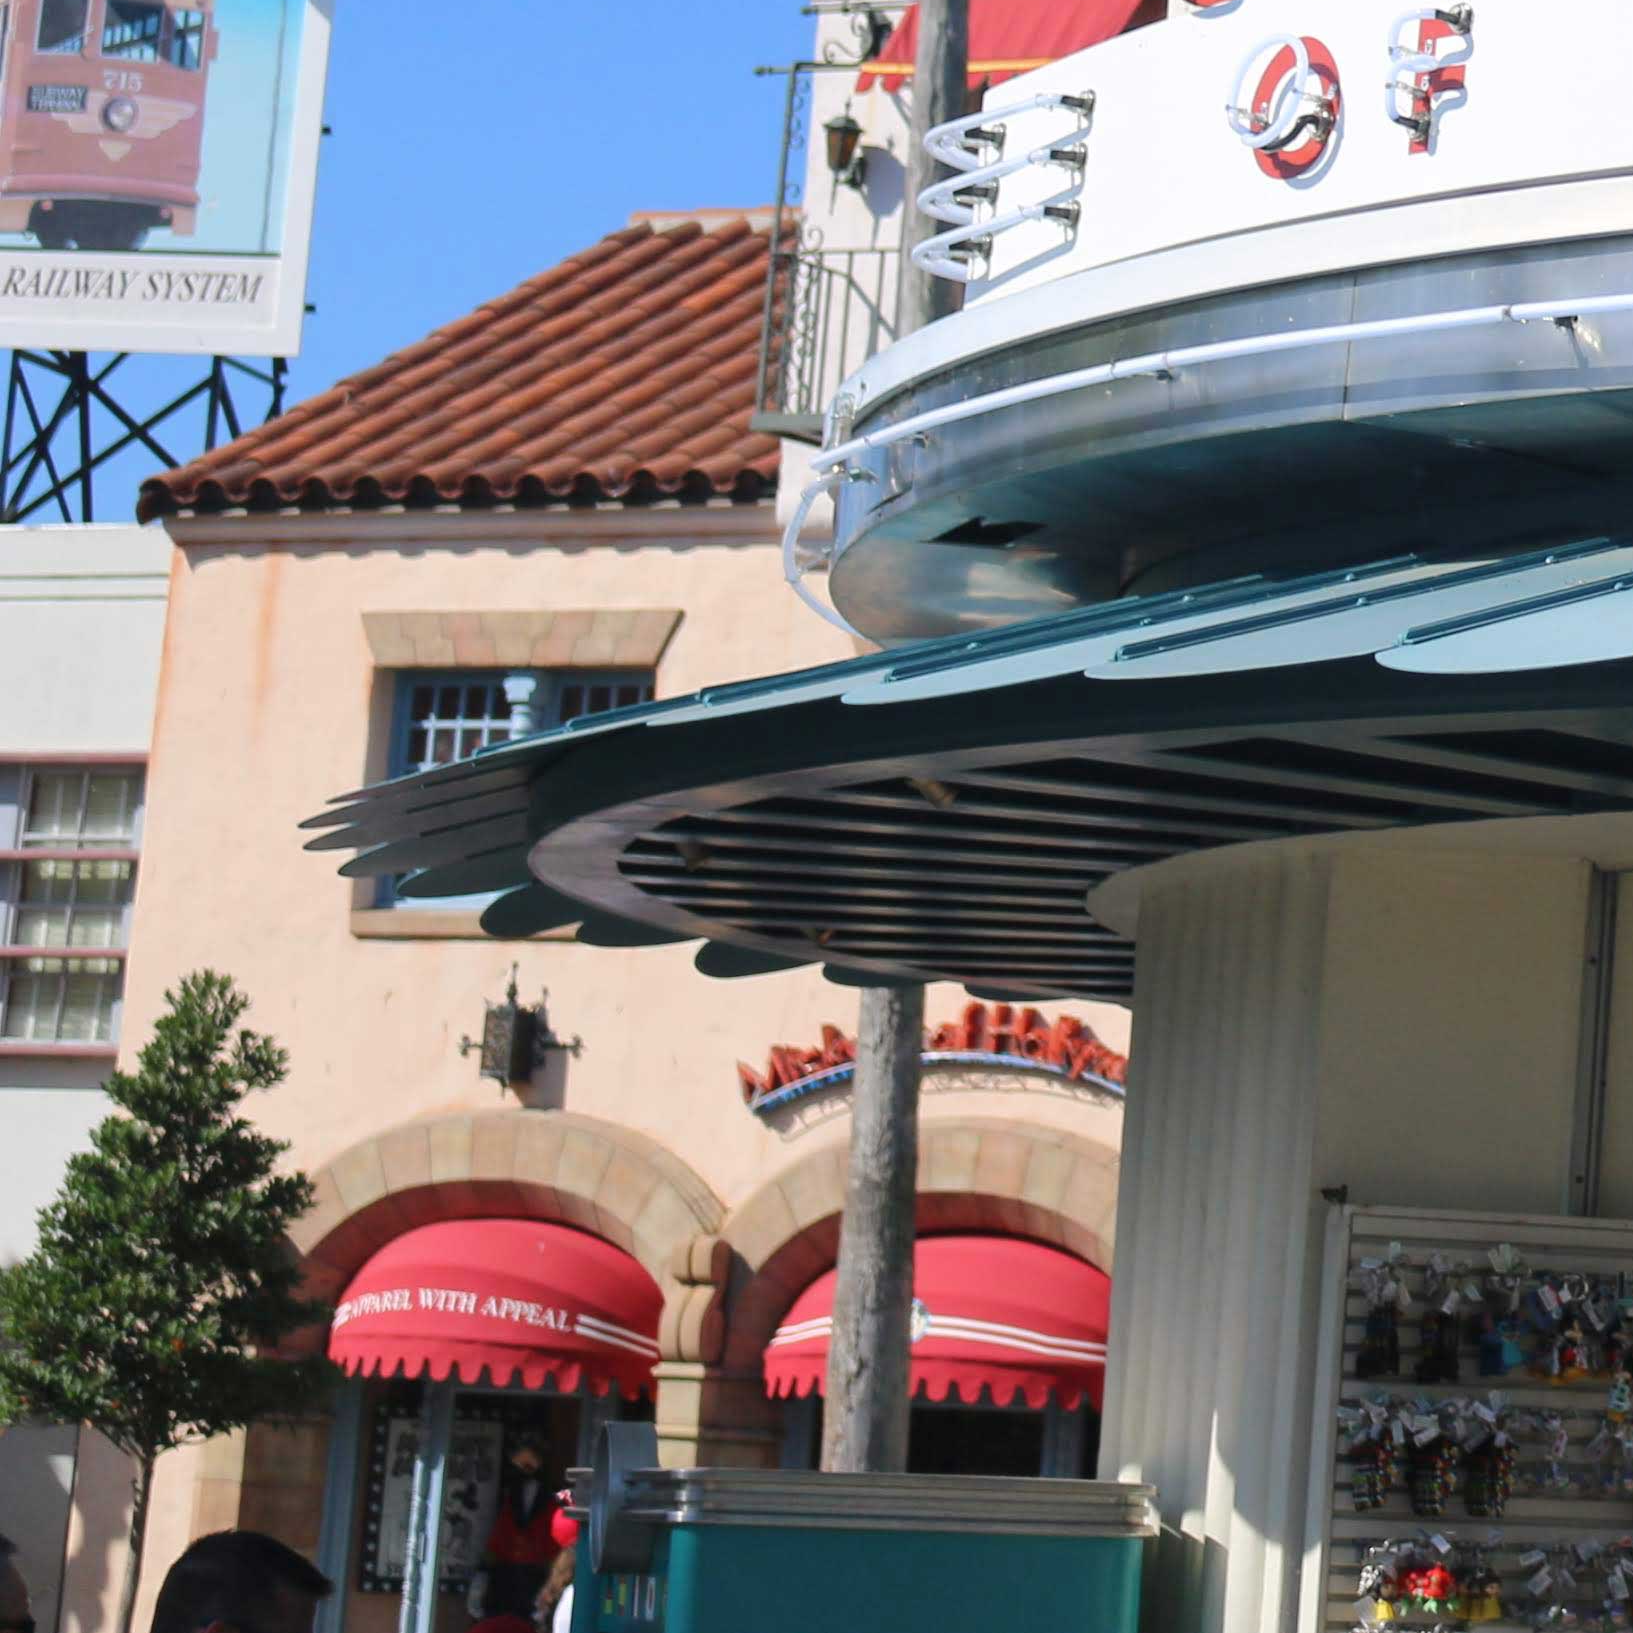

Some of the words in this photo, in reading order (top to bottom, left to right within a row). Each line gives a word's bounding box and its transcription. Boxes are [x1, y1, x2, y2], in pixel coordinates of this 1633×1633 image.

[1227, 2, 1475, 179] OF
[2, 265, 138, 301] RAILWAY
[142, 270, 265, 305] SYSTEM
[351, 1287, 413, 1319] APPAREL
[418, 1287, 479, 1315] WITH
[481, 1296, 572, 1333] APPEAL
